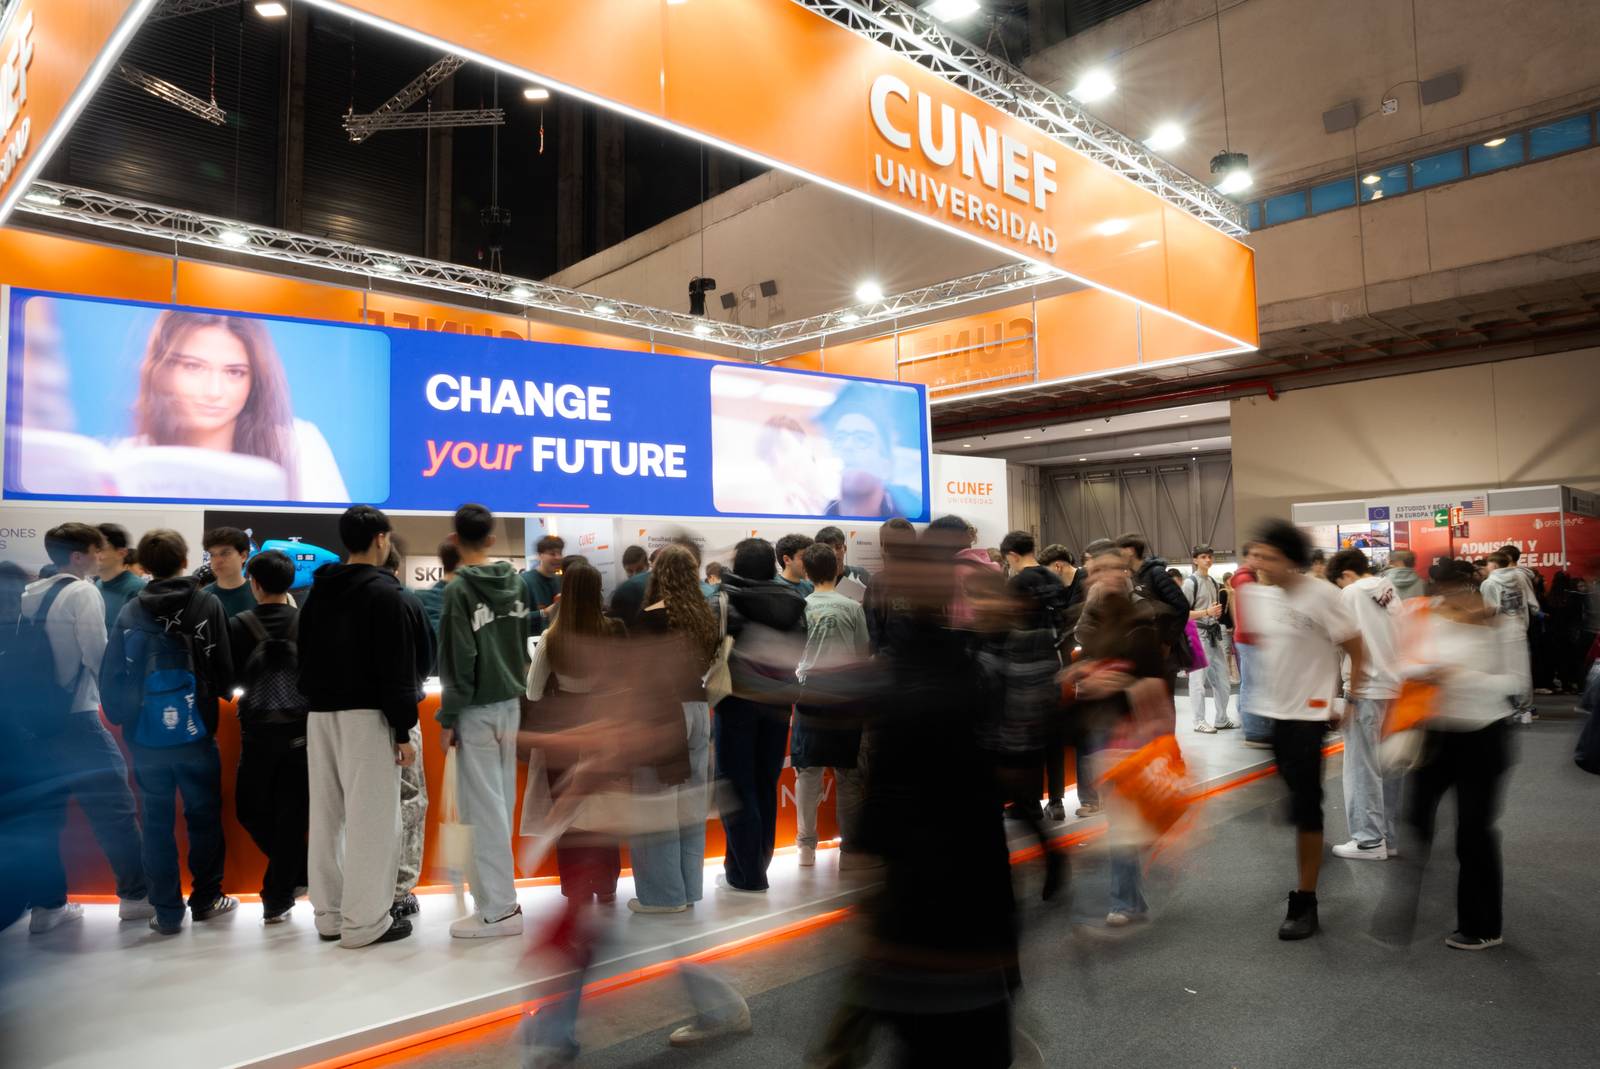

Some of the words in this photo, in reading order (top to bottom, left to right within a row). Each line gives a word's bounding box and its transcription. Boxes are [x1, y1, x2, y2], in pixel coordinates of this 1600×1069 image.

[870, 74, 1057, 211] CUNEF
[875, 154, 1057, 254] UNIVERSIDAD
[425, 373, 612, 422] CHANGE
[421, 439, 523, 477] your
[532, 436, 688, 478] FUTURE
[946, 480, 993, 496] CUNEF
[1405, 511, 1429, 519] EUROPA
[1517, 552, 1571, 567] EE.UU.
[1528, 540, 1538, 552] Y
